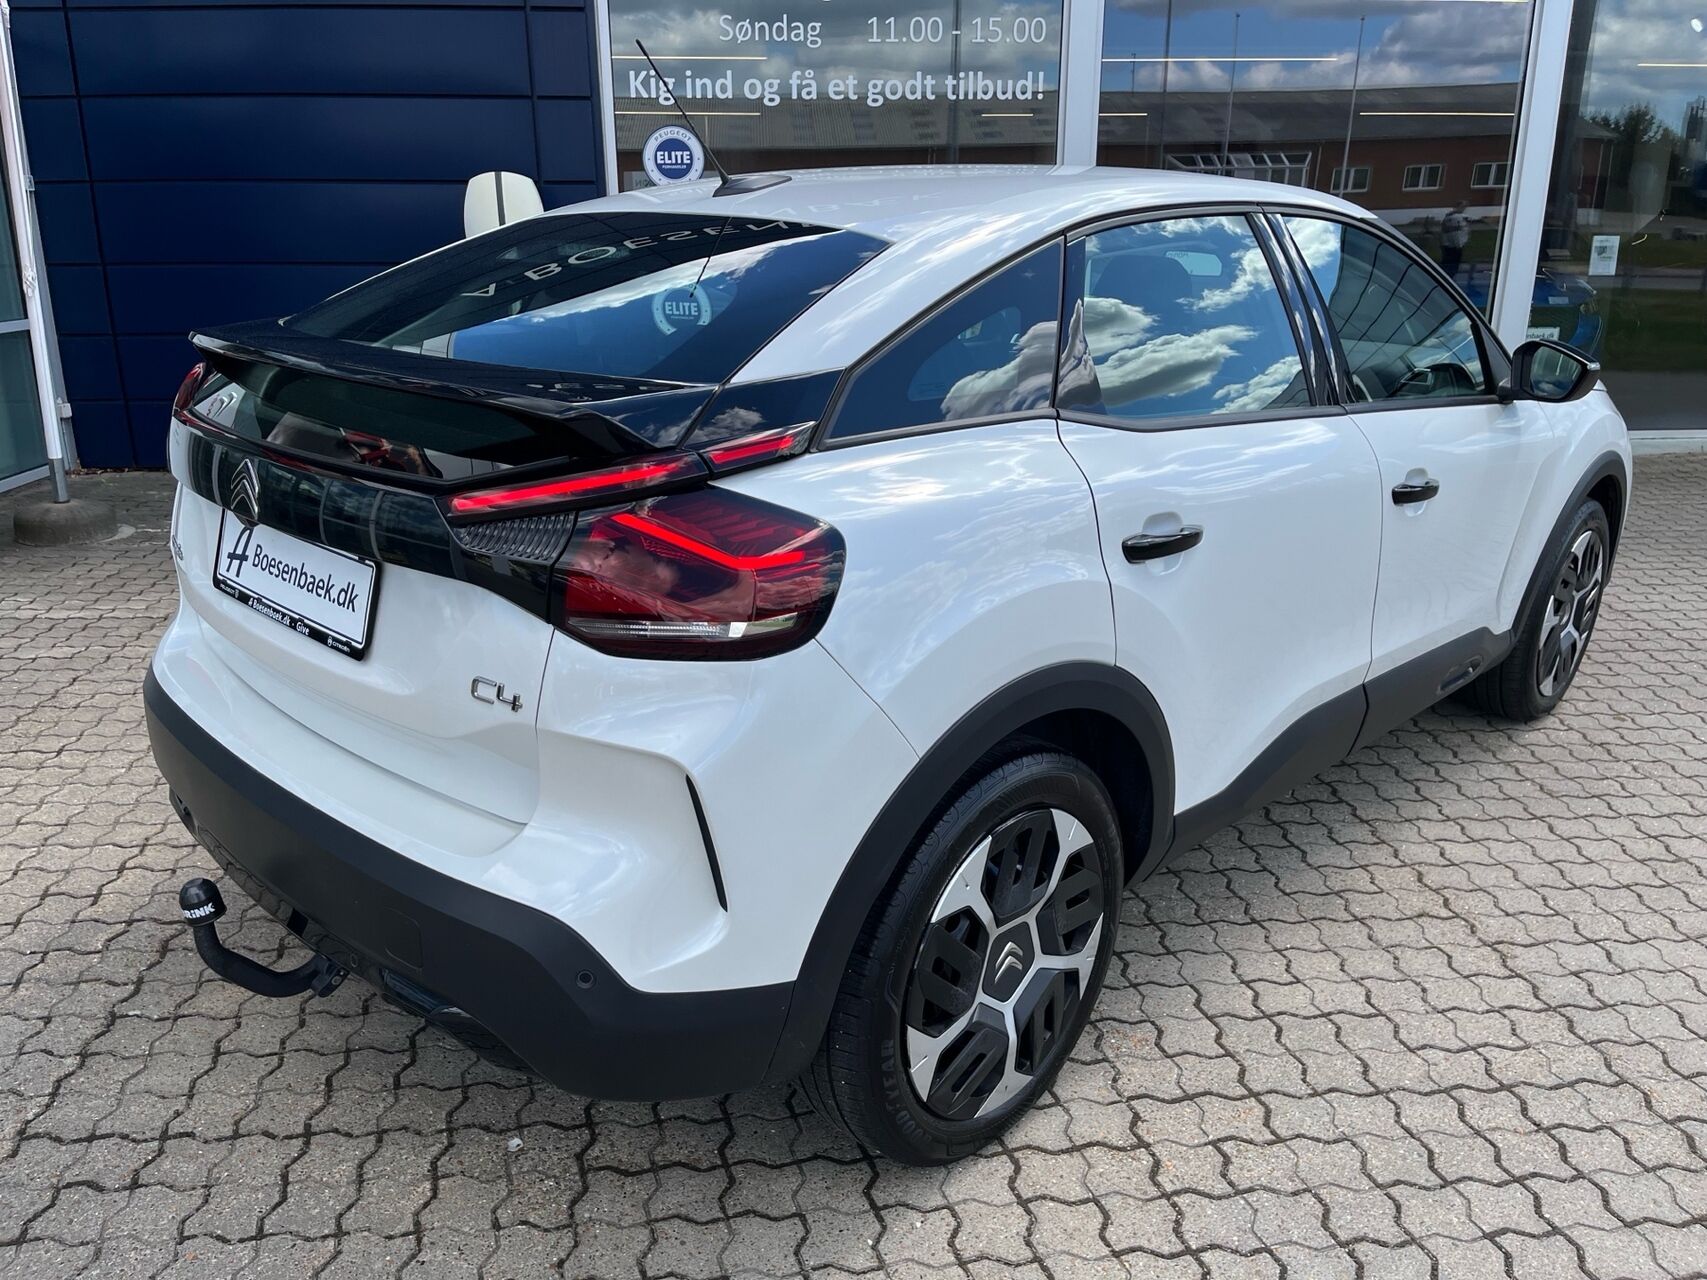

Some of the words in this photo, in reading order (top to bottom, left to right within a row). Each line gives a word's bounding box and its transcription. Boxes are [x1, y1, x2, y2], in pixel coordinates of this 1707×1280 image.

[719, 13, 822, 48] Søndag
[866, 17, 943, 43] 11.00
[970, 17, 1047, 43] 15.00
[629, 70, 676, 105] Kig
[685, 70, 733, 99] ind
[743, 77, 781, 106] og
[789, 70, 818, 100] få
[828, 74, 859, 101] et
[867, 71, 936, 107] godt
[944, 71, 1046, 100] tilbud!
[654, 129, 692, 142] PEUGEOT
[656, 151, 691, 164] ELITE
[664, 301, 699, 316] ELITE
[252, 543, 360, 613] Boesenbaek.dk
[296, 621, 310, 636] Give
[471, 675, 523, 712] C4
